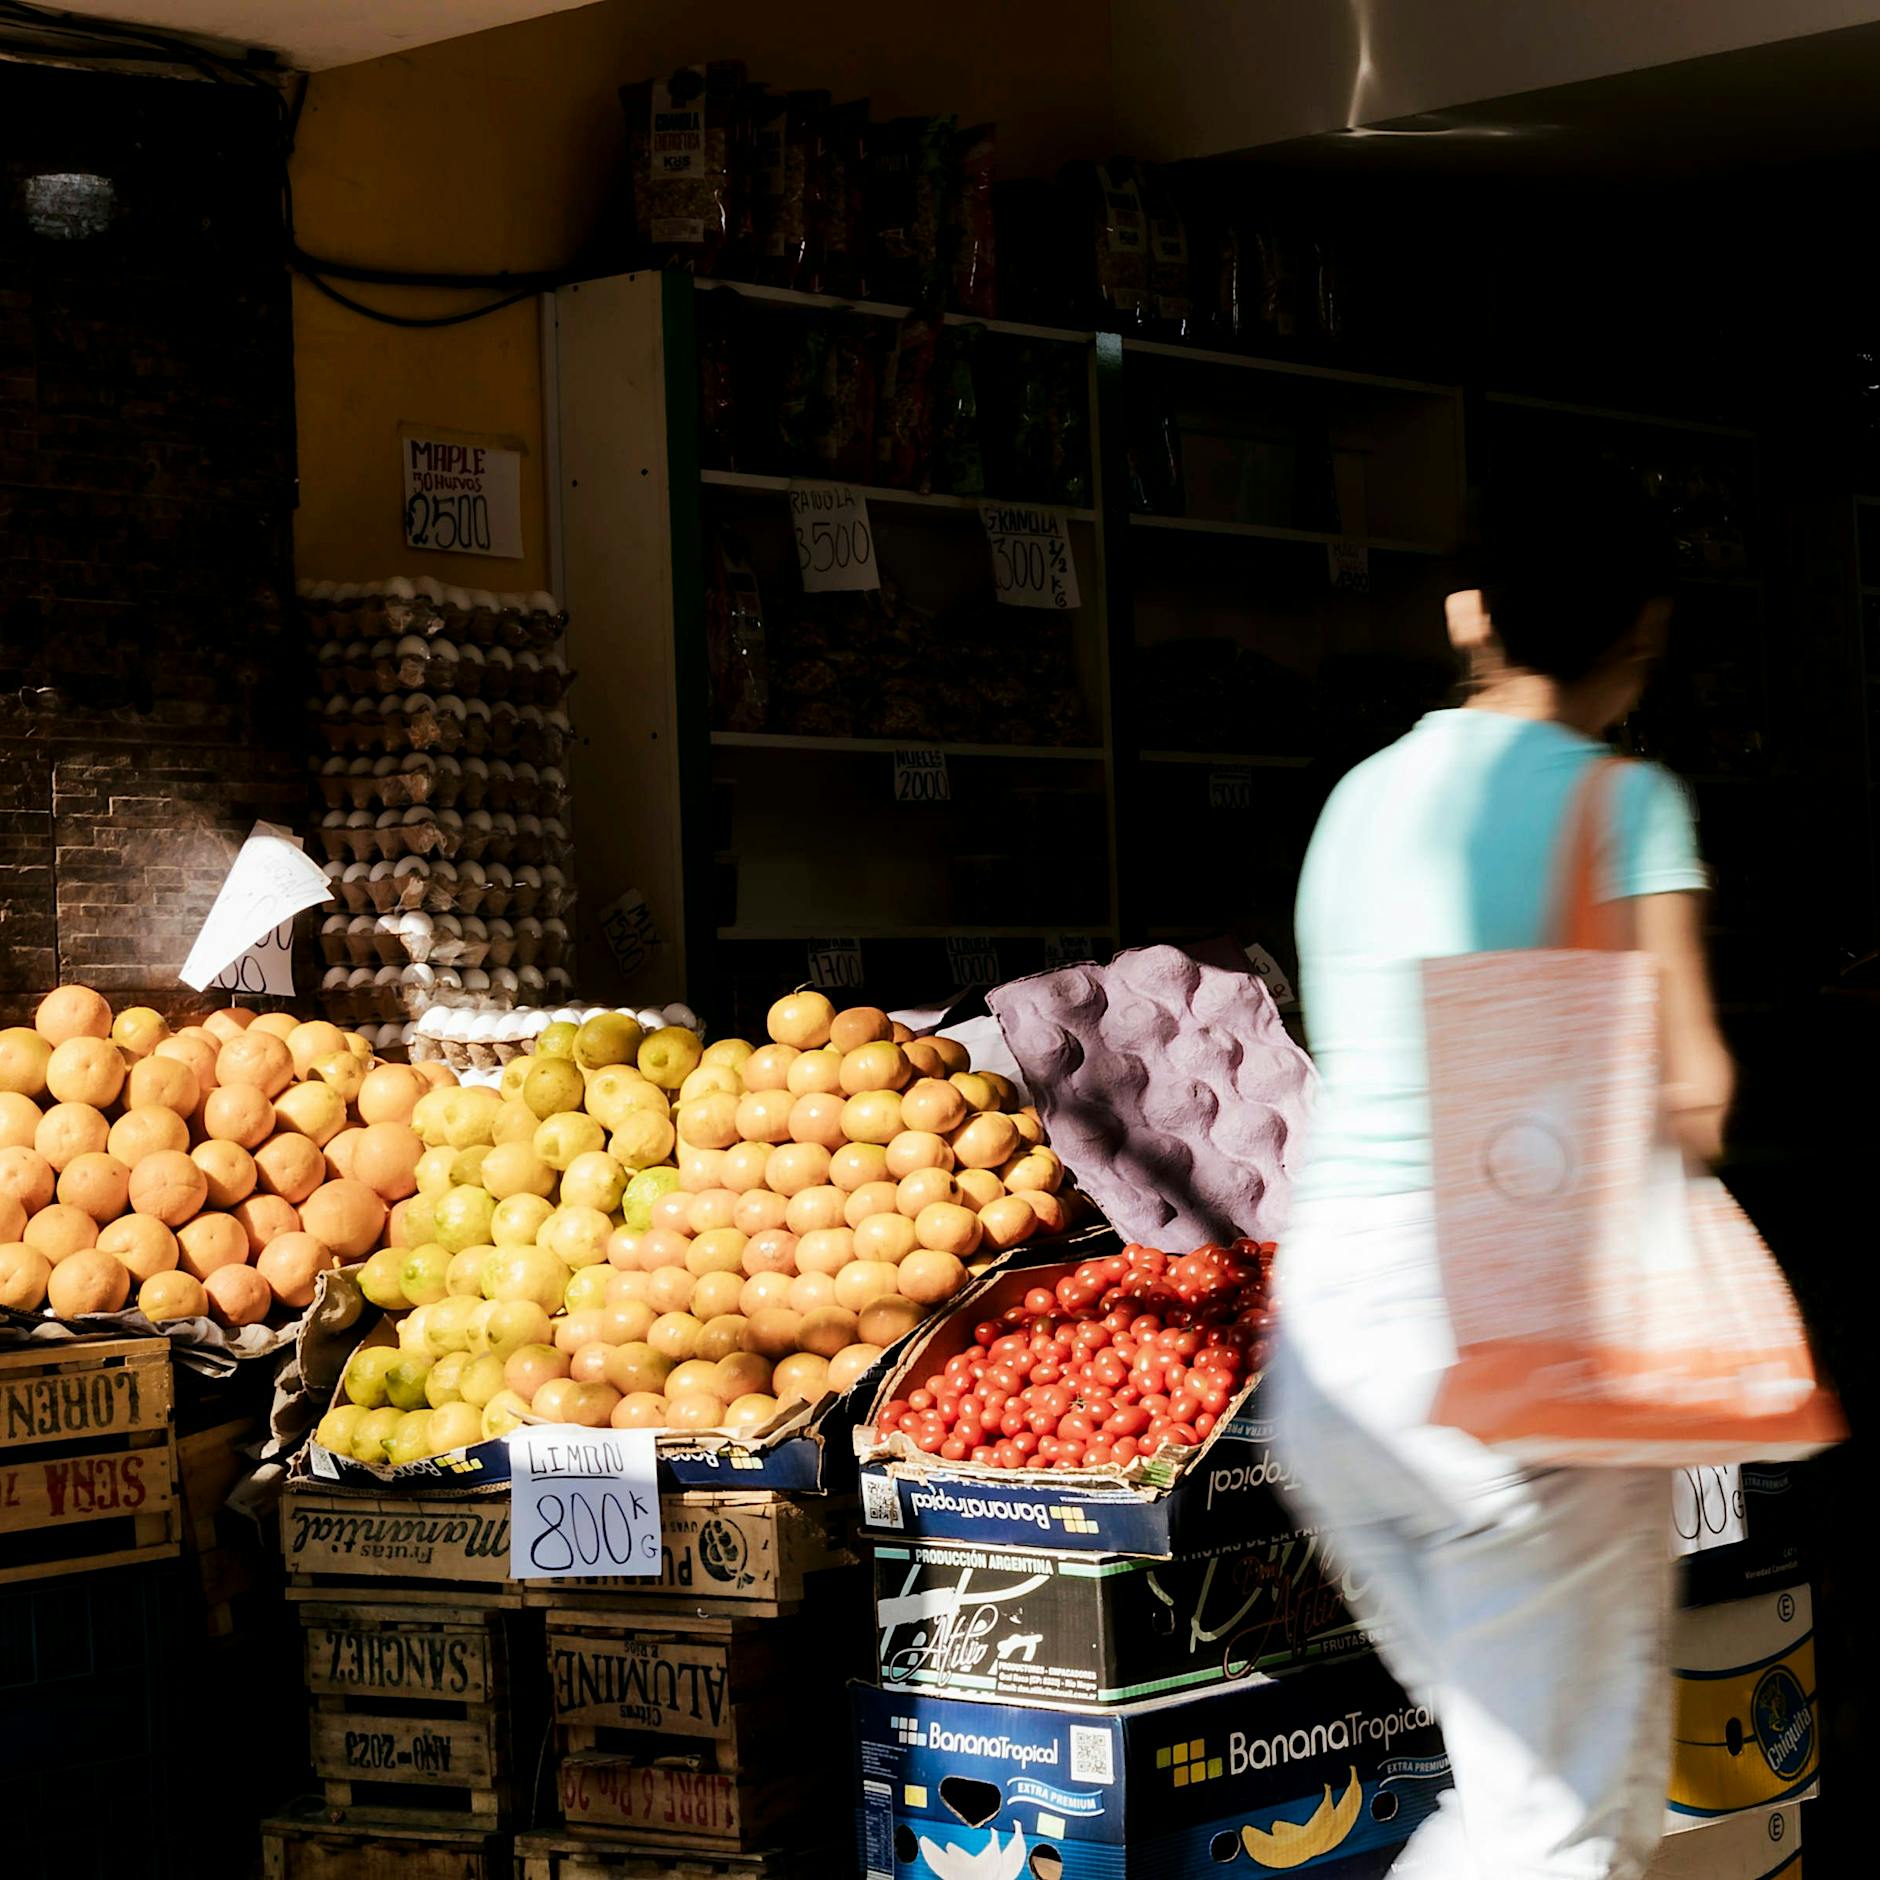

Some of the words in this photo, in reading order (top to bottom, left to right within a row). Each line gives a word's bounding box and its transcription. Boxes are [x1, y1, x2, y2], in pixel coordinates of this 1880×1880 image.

[410, 439, 487, 476] MAPLE
[789, 487, 856, 515] RANOLA
[407, 492, 491, 551] 2500
[899, 770, 949, 801] 2000
[811, 955, 861, 986] 1700
[953, 955, 997, 984] 1000
[0, 1370, 142, 1439] LOREN
[528, 1441, 624, 1475] LIMON
[0, 1471, 21, 1508] 7
[44, 1455, 147, 1517] SEÑA
[1206, 1449, 1302, 1511] Tropical
[910, 1491, 1051, 1530] BananaTropical
[1672, 1465, 1727, 1540] 00
[293, 1507, 513, 1558] Manantial
[530, 1492, 632, 1571] 800
[360, 1543, 434, 1564] Frutas
[915, 1549, 987, 1569] PRODUCCIÓN
[988, 1555, 1054, 1576] ARGENTINA
[326, 1630, 469, 1694] SANCHEZ
[1322, 1633, 1368, 1654] FRUTAS
[555, 1649, 729, 1728] ALUMINE
[929, 1721, 1059, 1770] BananaTropical
[1229, 1705, 1436, 1776] BananaTropical
[1766, 1704, 1812, 1772] Chiquita
[1386, 1760, 1414, 1776] EXTRA
[1017, 1781, 1049, 1800] EXTRA
[1050, 1791, 1097, 1810] PREMIUM
